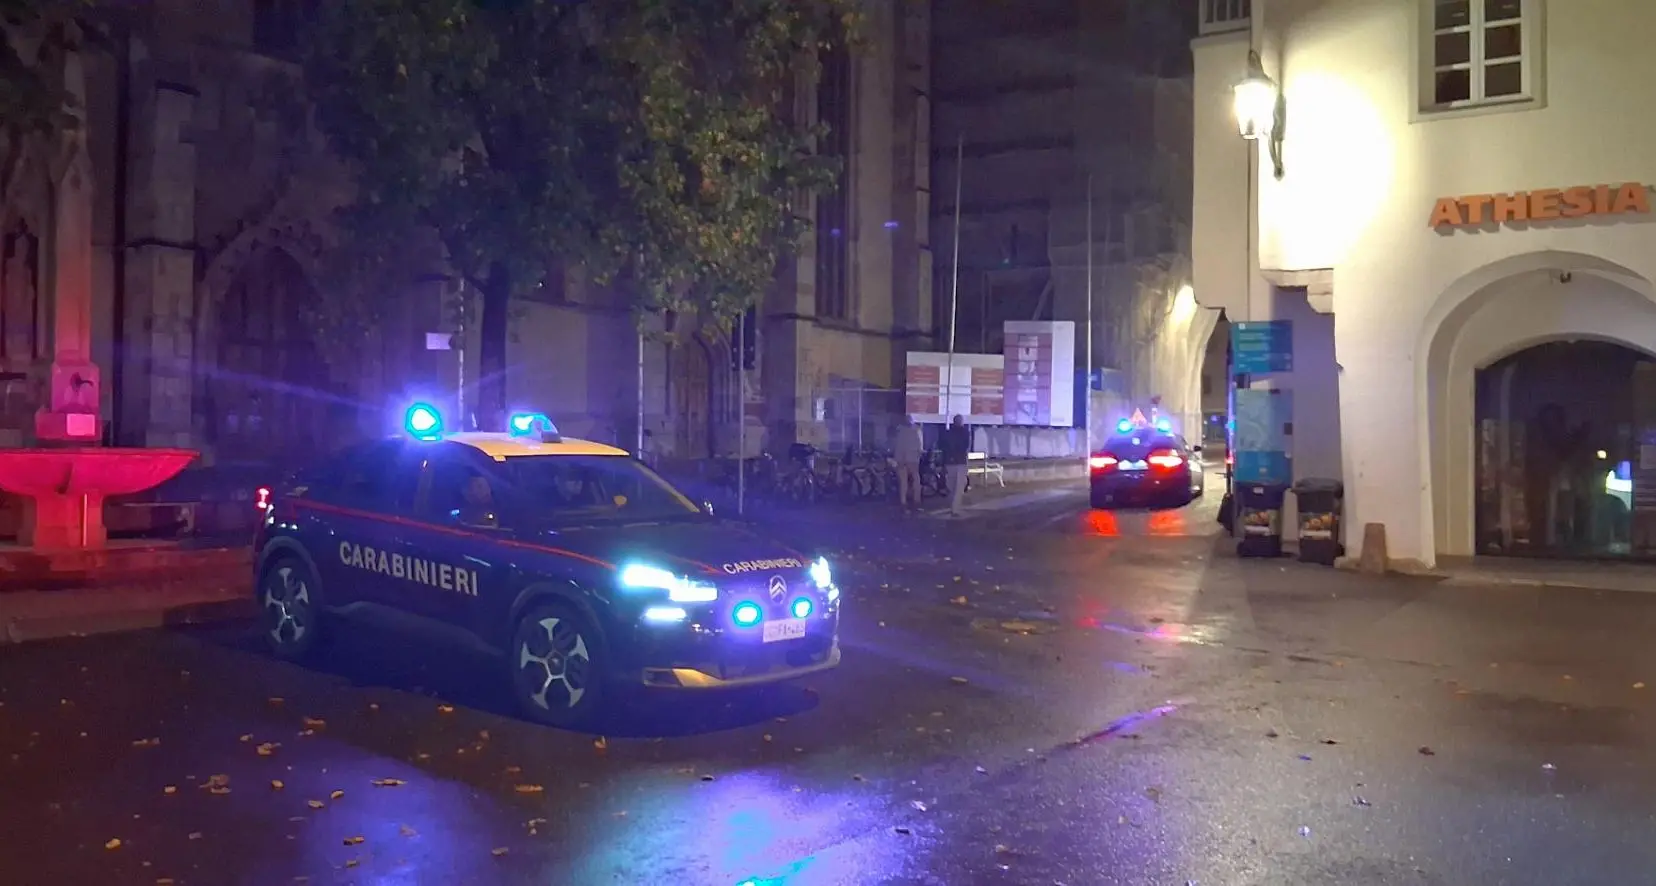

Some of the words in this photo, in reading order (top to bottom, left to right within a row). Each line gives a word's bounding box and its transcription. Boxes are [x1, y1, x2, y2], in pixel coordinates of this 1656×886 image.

[1428, 182, 1650, 228] ATHESIA
[339, 540, 478, 597] CARABINIERI
[723, 558, 802, 575] CARABINIERI
